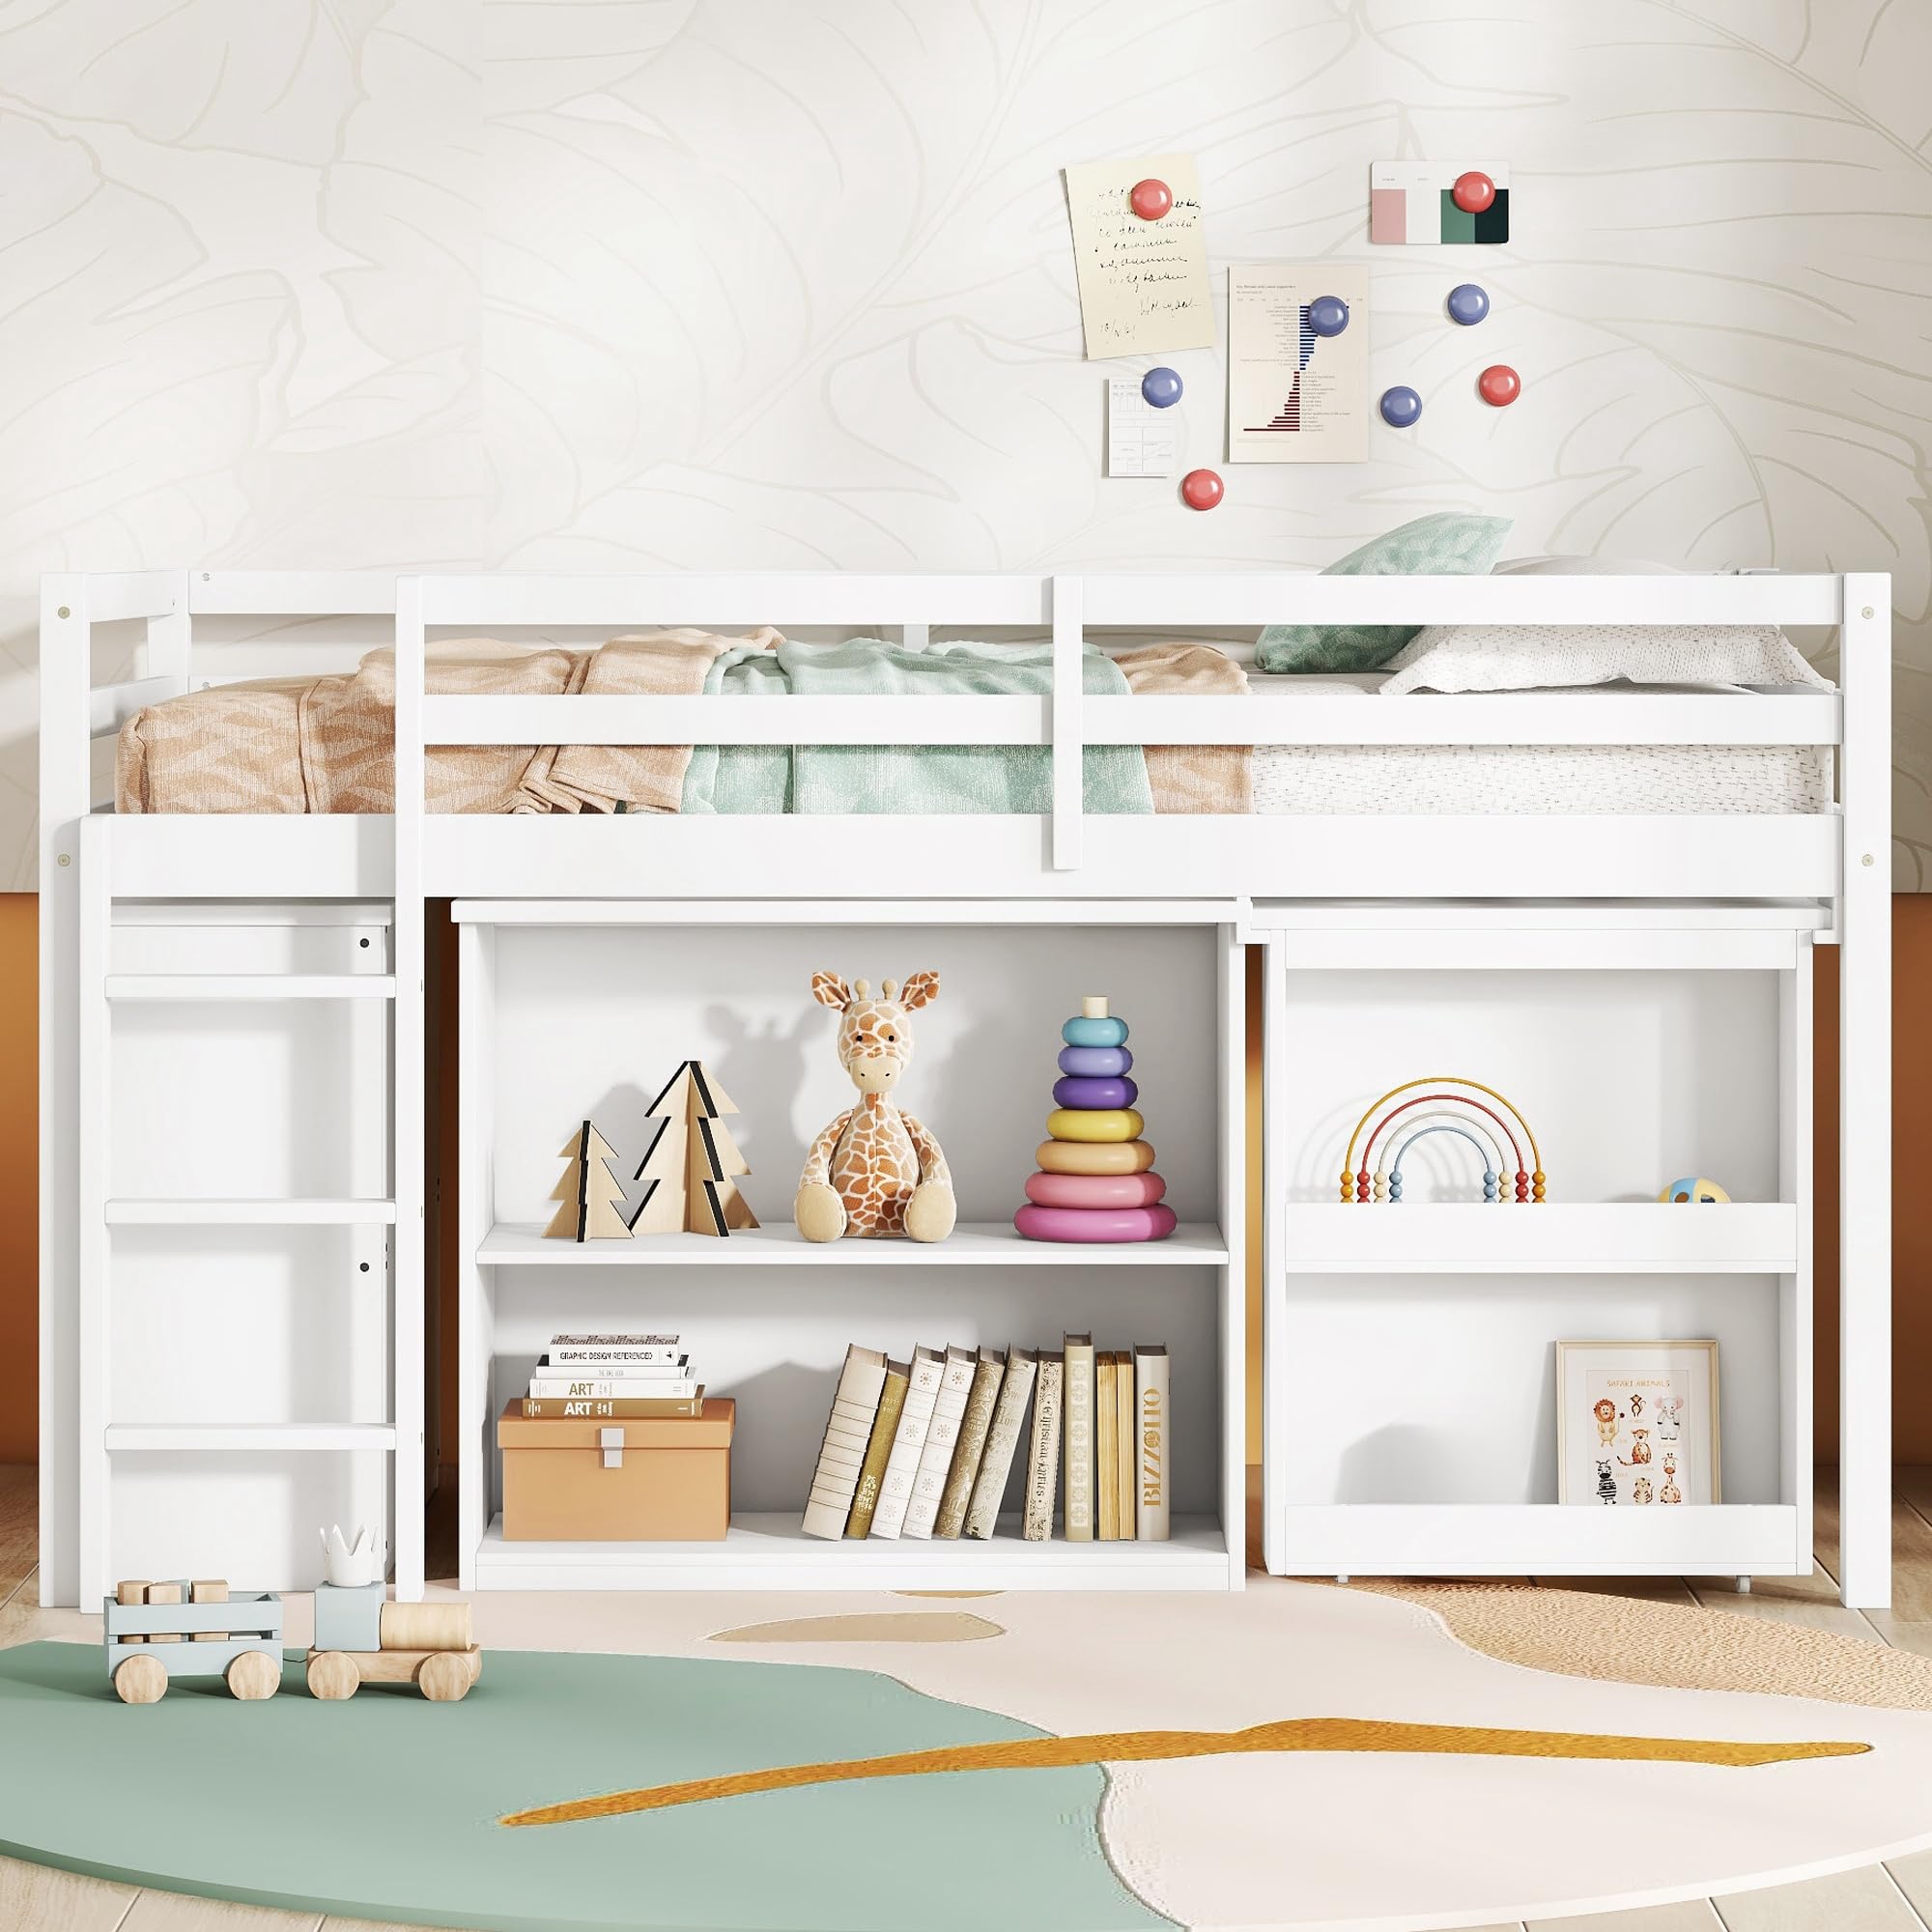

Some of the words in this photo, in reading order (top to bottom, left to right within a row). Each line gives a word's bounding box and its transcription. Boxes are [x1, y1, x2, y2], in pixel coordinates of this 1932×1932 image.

[559, 1351, 587, 1360] GRAPHIC
[589, 1351, 611, 1360] DESIGN
[612, 1351, 653, 1360] REFERENCED
[568, 1382, 595, 1397] ART
[563, 1401, 593, 1415] ART
